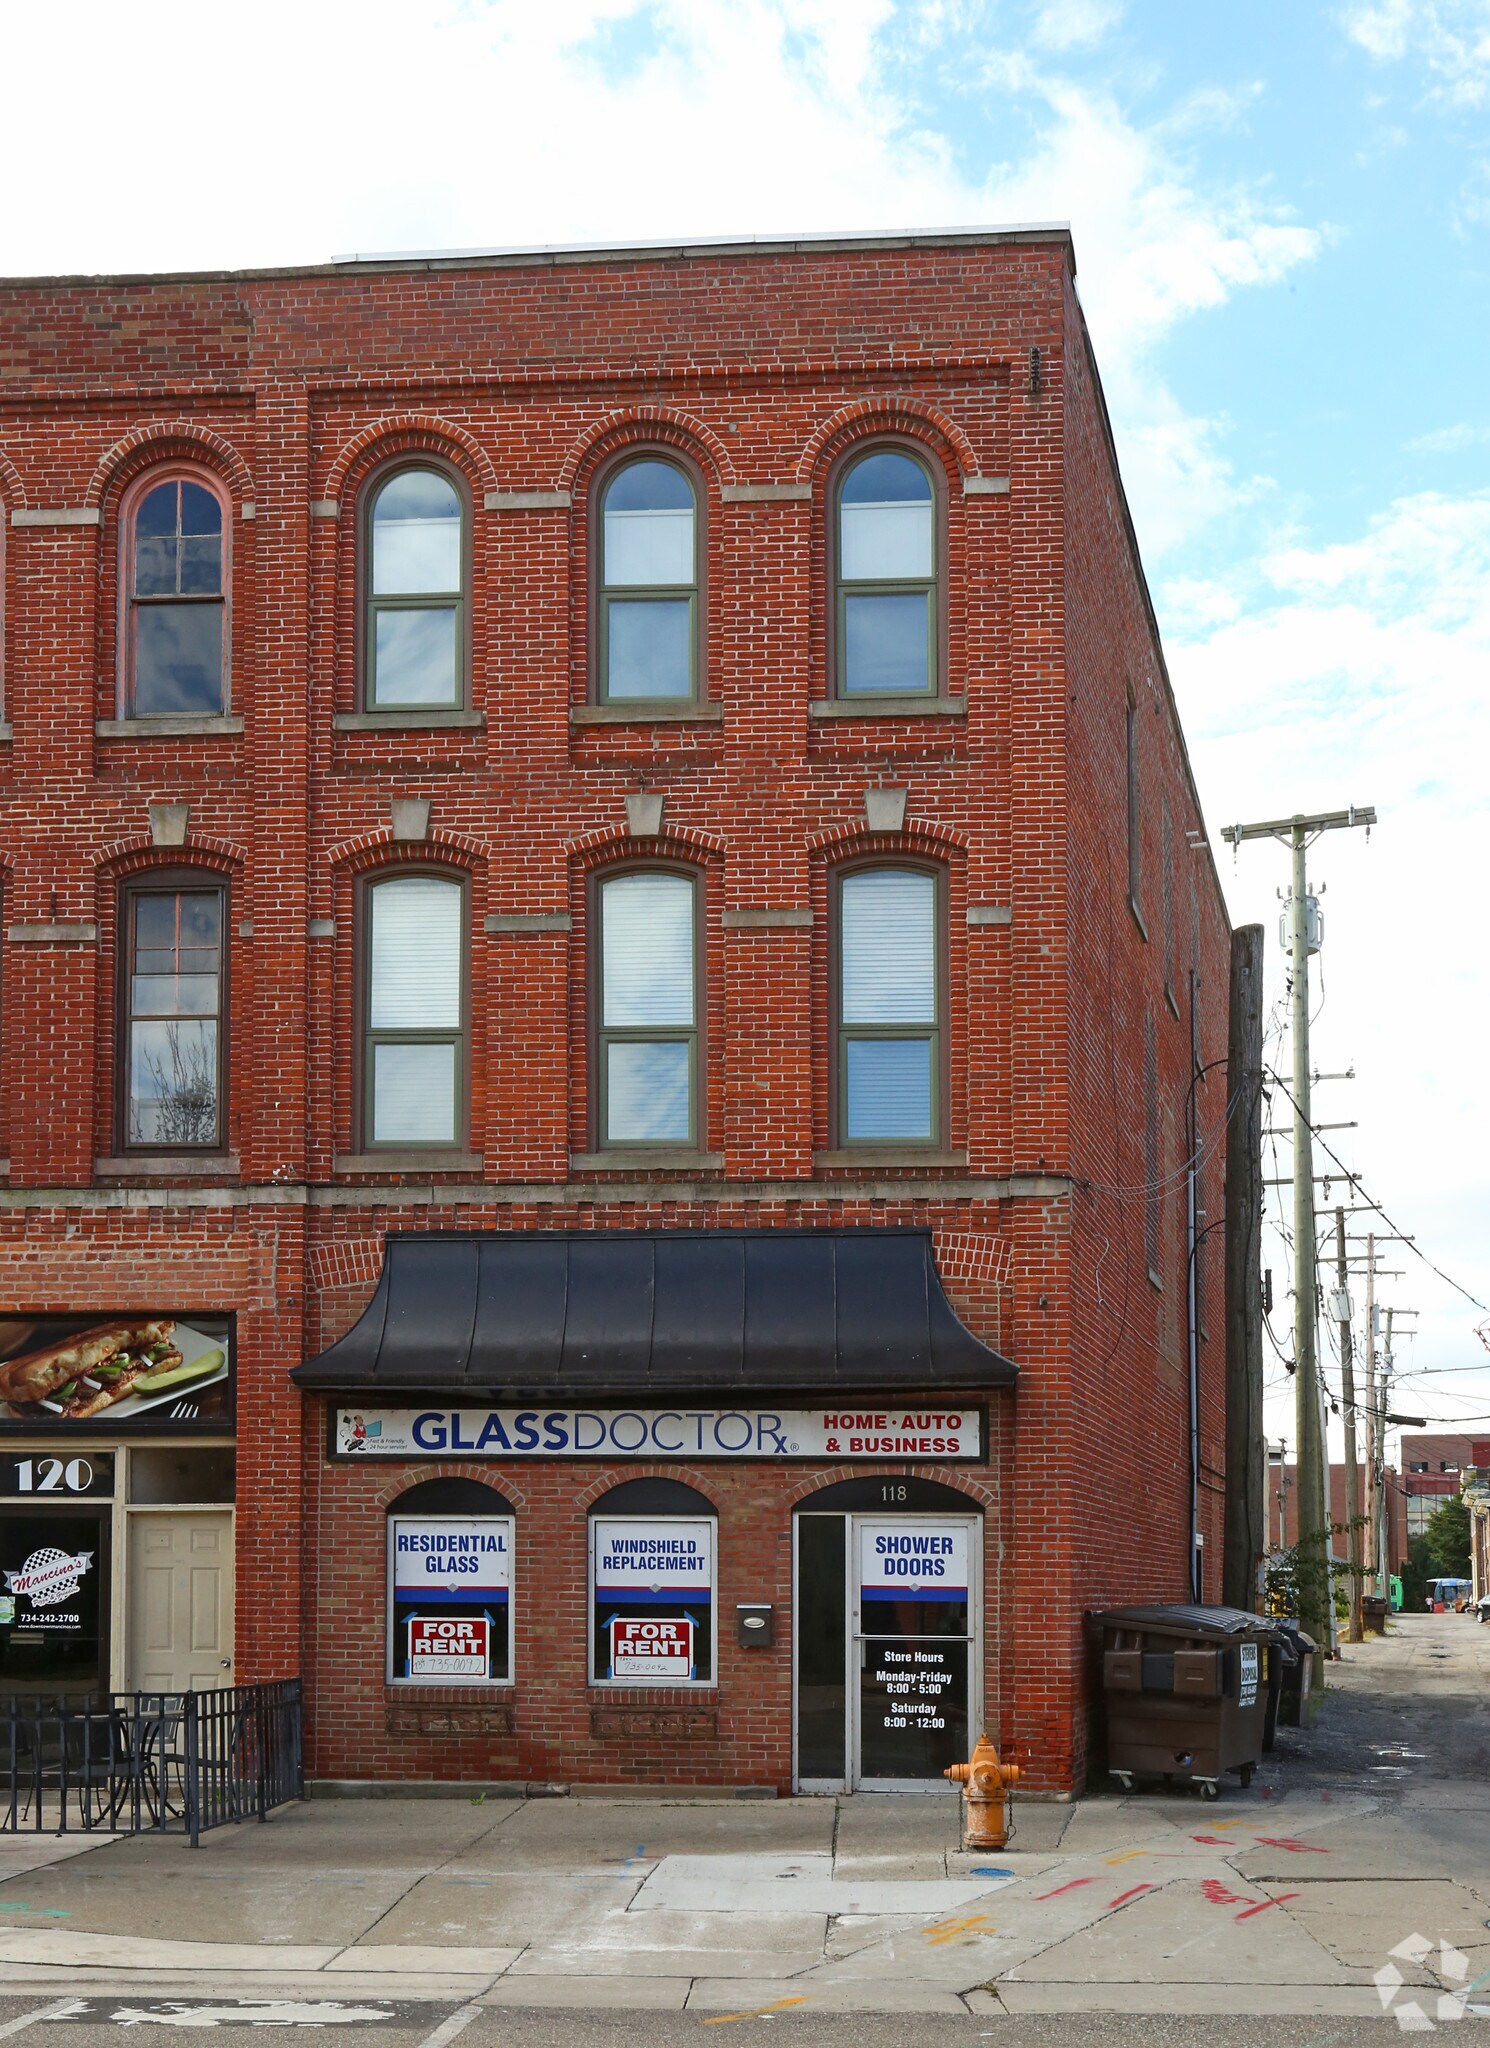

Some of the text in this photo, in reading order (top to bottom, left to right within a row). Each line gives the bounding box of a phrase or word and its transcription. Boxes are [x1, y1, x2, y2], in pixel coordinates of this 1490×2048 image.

[823, 1414, 962, 1430] HOME AUTO
[826, 1438, 960, 1452] & BUSINESS
[14, 1458, 93, 1491] 120
[882, 1486, 907, 1500] 118
[398, 1535, 507, 1552] RESIDENTIAL
[611, 1540, 696, 1554] WINDSHIELD
[876, 1536, 953, 1554] SHOWER
[426, 1556, 479, 1573] GLASS
[603, 1556, 705, 1570] REPLACEMENT
[884, 1558, 946, 1576] DOORS
[12, 1558, 84, 1592] Mancino's
[20, 1614, 80, 1622] 734-242-2700
[422, 1622, 474, 1638] FOR
[626, 1624, 677, 1639] FOR
[415, 1639, 482, 1654] RENT
[618, 1640, 686, 1655] RENT
[884, 1651, 944, 1663] Store Hours
[428, 1658, 482, 1672] 735-0092
[876, 1671, 952, 1684] Monday-Friday
[886, 1683, 909, 1694] 8:00
[919, 1684, 942, 1694] 5:00
[891, 1702, 936, 1716] Saturday
[884, 1717, 906, 1728] 8:00
[916, 1718, 945, 1728] 12:00
